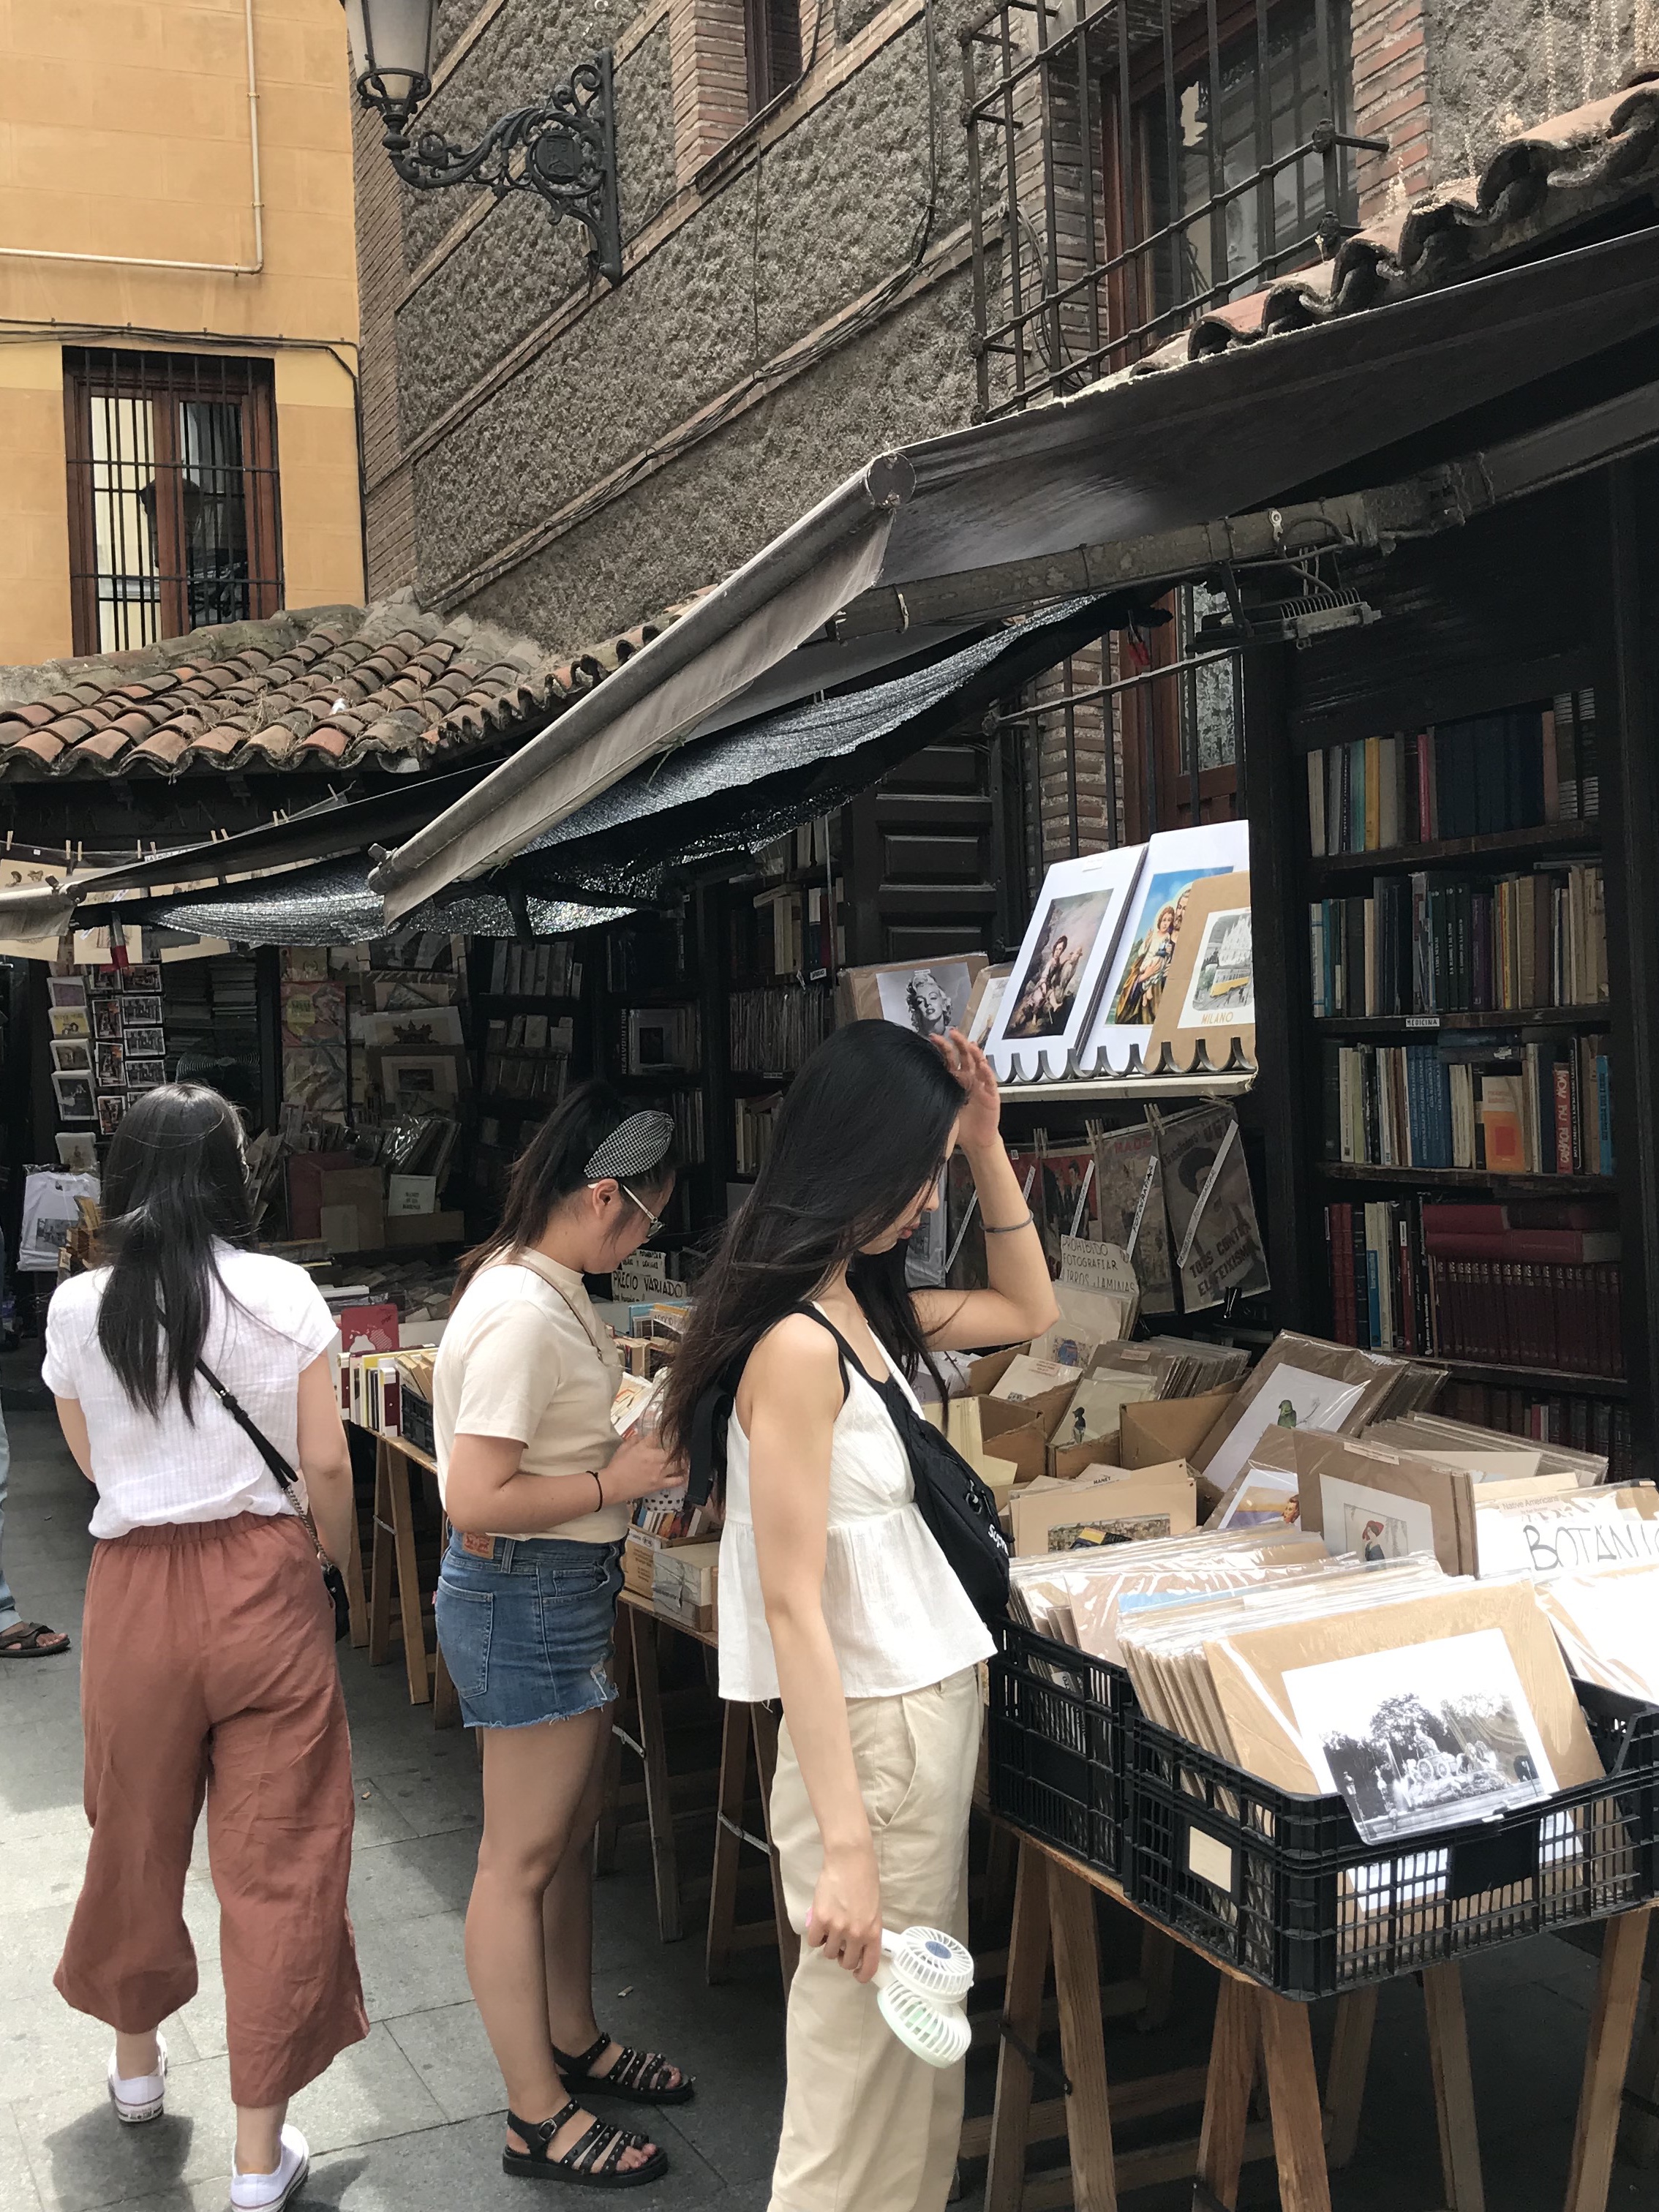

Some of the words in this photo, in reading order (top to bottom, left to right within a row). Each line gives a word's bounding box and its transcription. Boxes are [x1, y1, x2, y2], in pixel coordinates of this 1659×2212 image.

[1200, 1011, 1234, 1025] MILANO
[1407, 1018, 1438, 1026] MEDICINA
[1061, 1235, 1109, 1257] PROHIBIDO
[1063, 1252, 1118, 1271] FOTOGRAFIAR
[612, 1271, 639, 1290] PRECIO
[644, 1276, 683, 1298] VARIADO
[1501, 1500, 1524, 1511] Native
[1525, 1495, 1560, 1507] Americans
